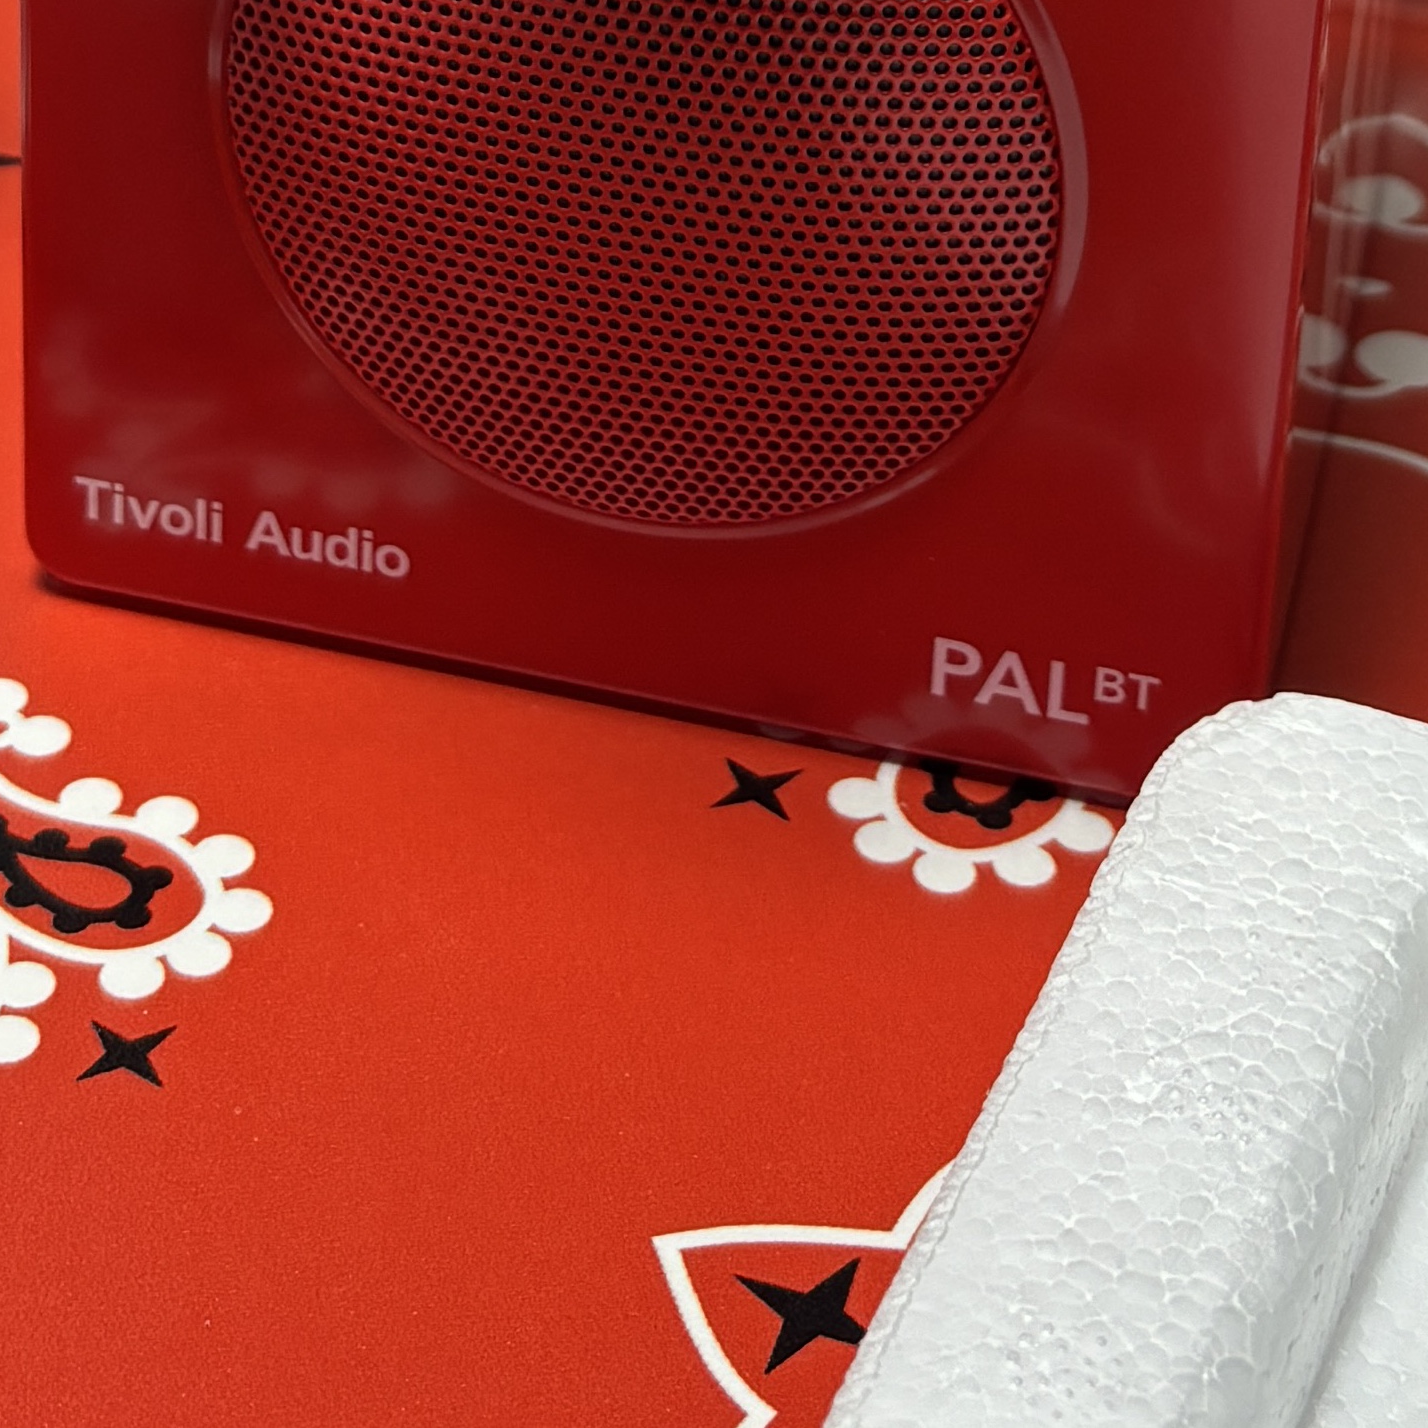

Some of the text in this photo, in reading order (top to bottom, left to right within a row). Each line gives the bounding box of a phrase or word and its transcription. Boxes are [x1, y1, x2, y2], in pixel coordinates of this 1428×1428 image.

[75, 476, 410, 578] Tivoli Audio
[930, 637, 1161, 725] PAL BT
